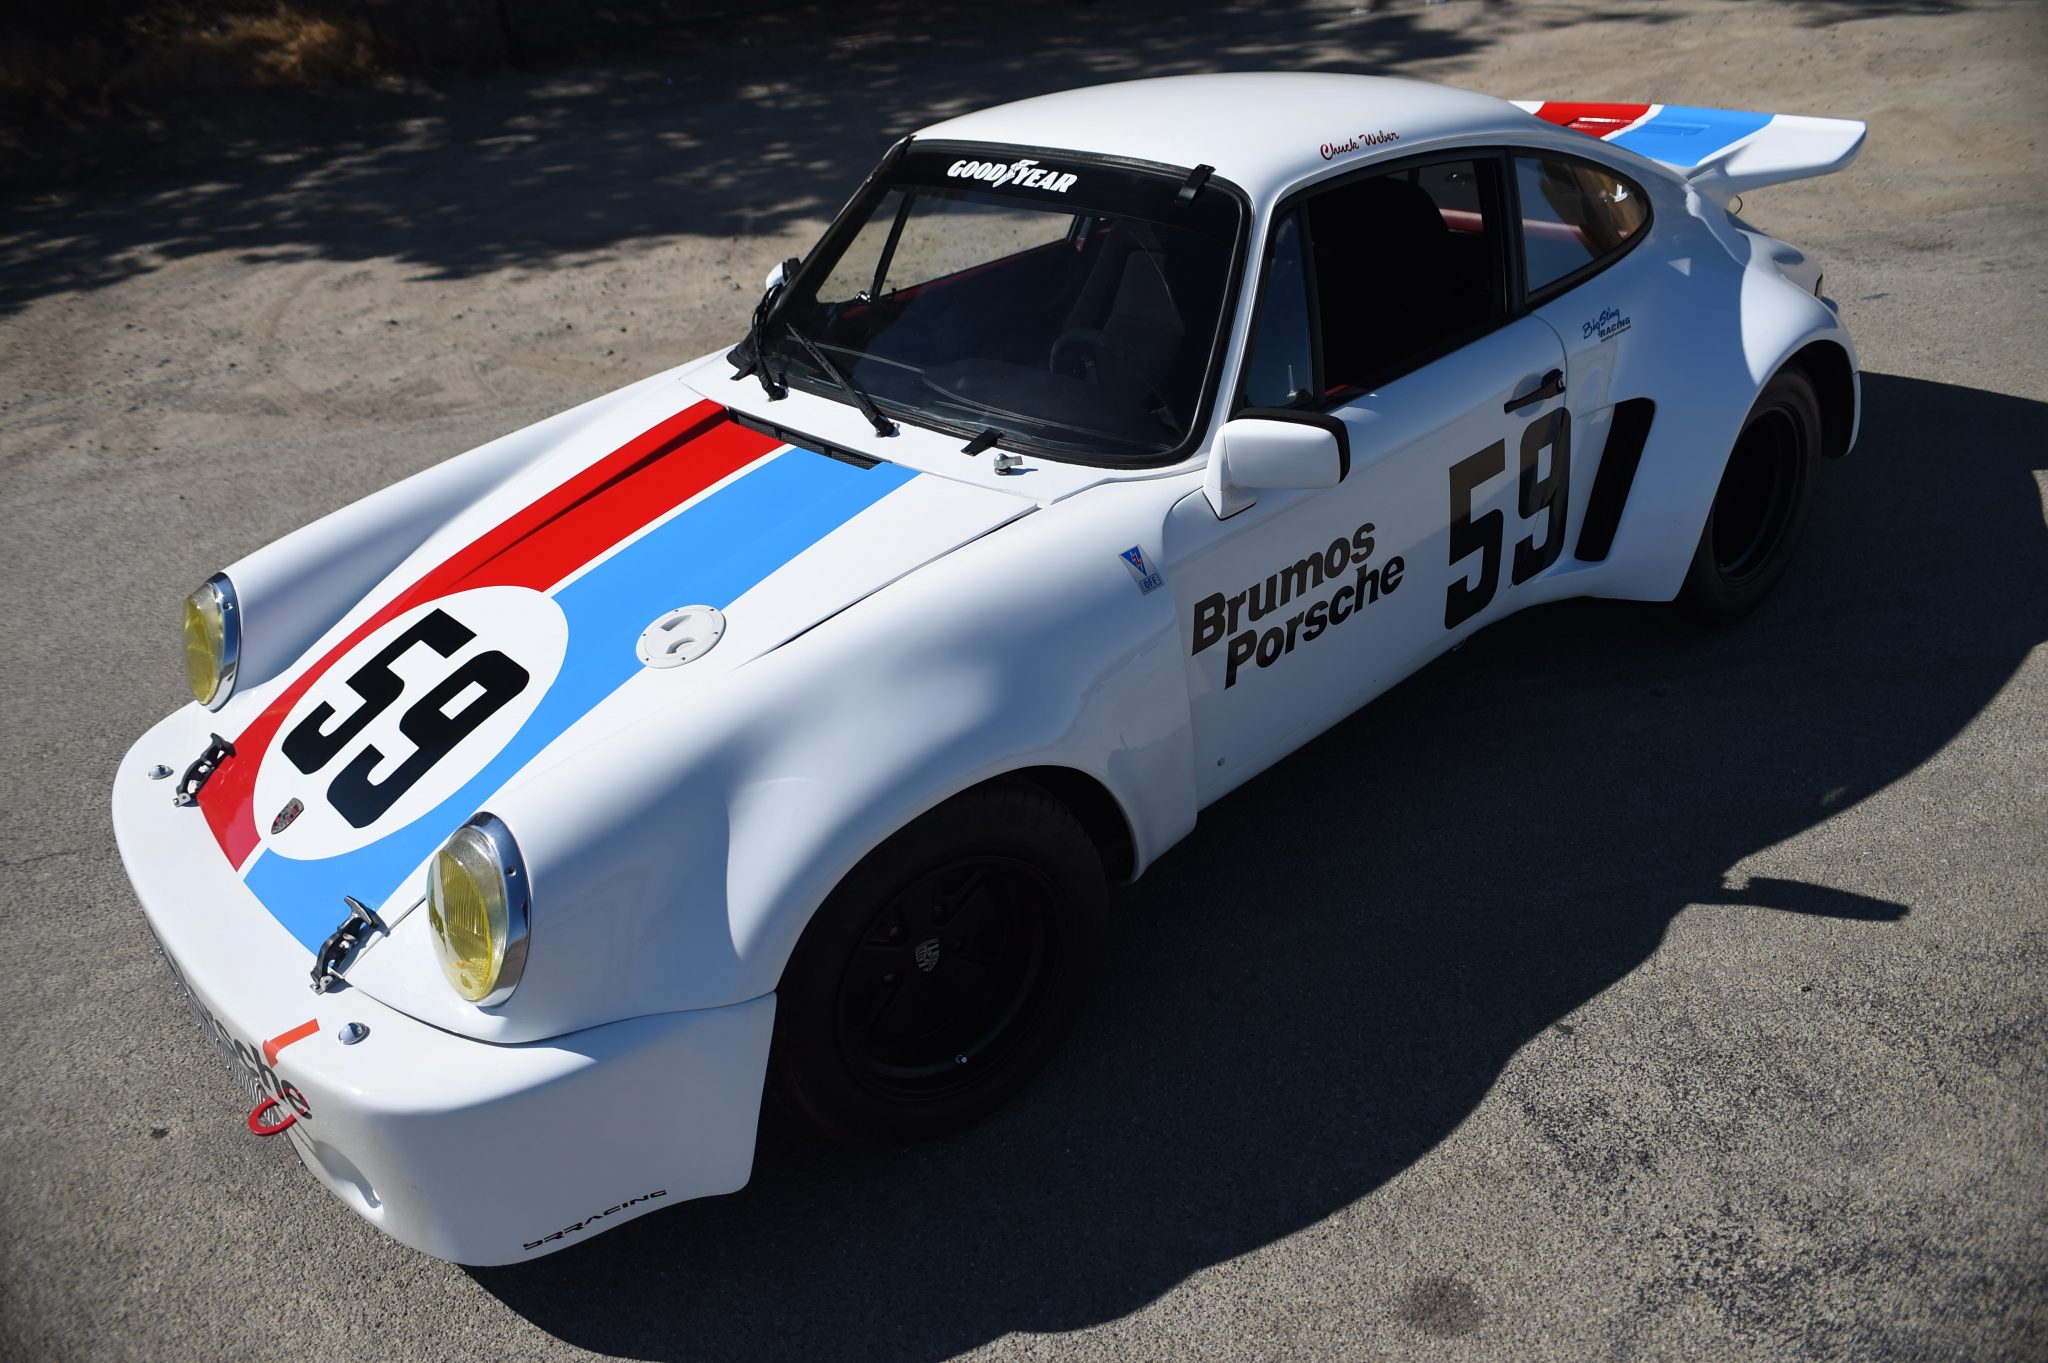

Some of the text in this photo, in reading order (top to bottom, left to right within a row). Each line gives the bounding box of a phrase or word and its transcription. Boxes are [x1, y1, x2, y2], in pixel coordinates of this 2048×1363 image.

[947, 159, 1078, 193] GOODYEAR
[1320, 129, 1400, 160] Chuck Weber
[1599, 316, 1631, 338] RACING
[1444, 407, 1572, 630] 59
[1191, 522, 1376, 656] Brumos
[1223, 555, 1406, 690] Porsche
[281, 608, 530, 828] 59
